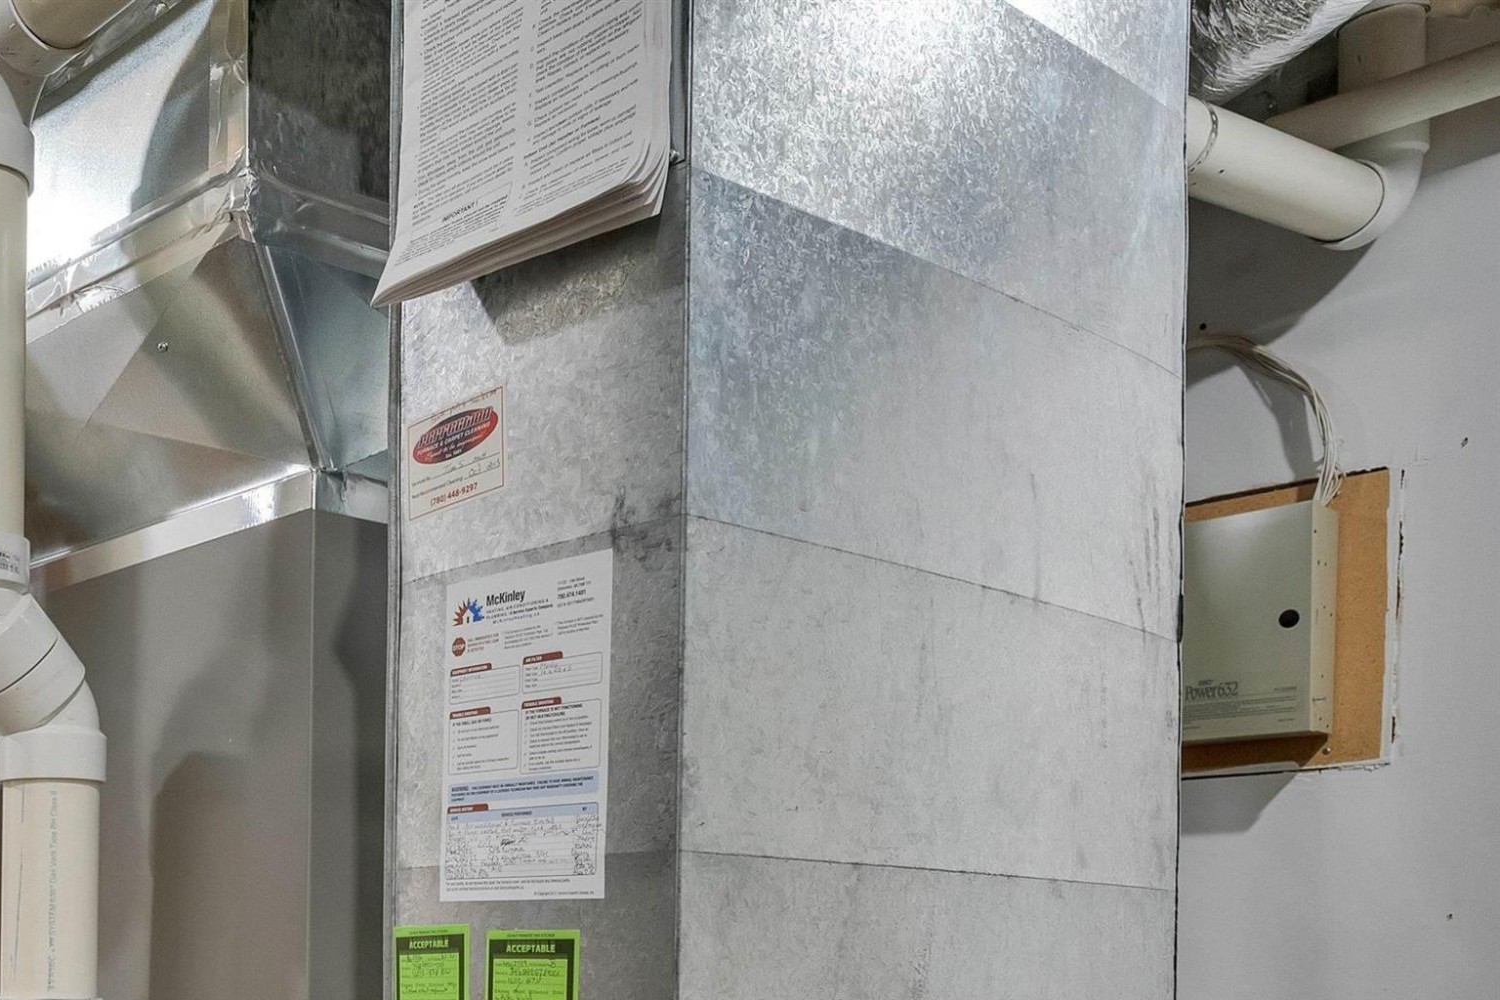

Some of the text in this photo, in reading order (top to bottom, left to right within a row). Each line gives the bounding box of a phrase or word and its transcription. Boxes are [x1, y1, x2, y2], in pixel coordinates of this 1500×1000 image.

[486, 590, 526, 606] McKinley
[409, 939, 449, 949] ACCEPTABLE
[506, 945, 556, 953] ACCEPTABLE
